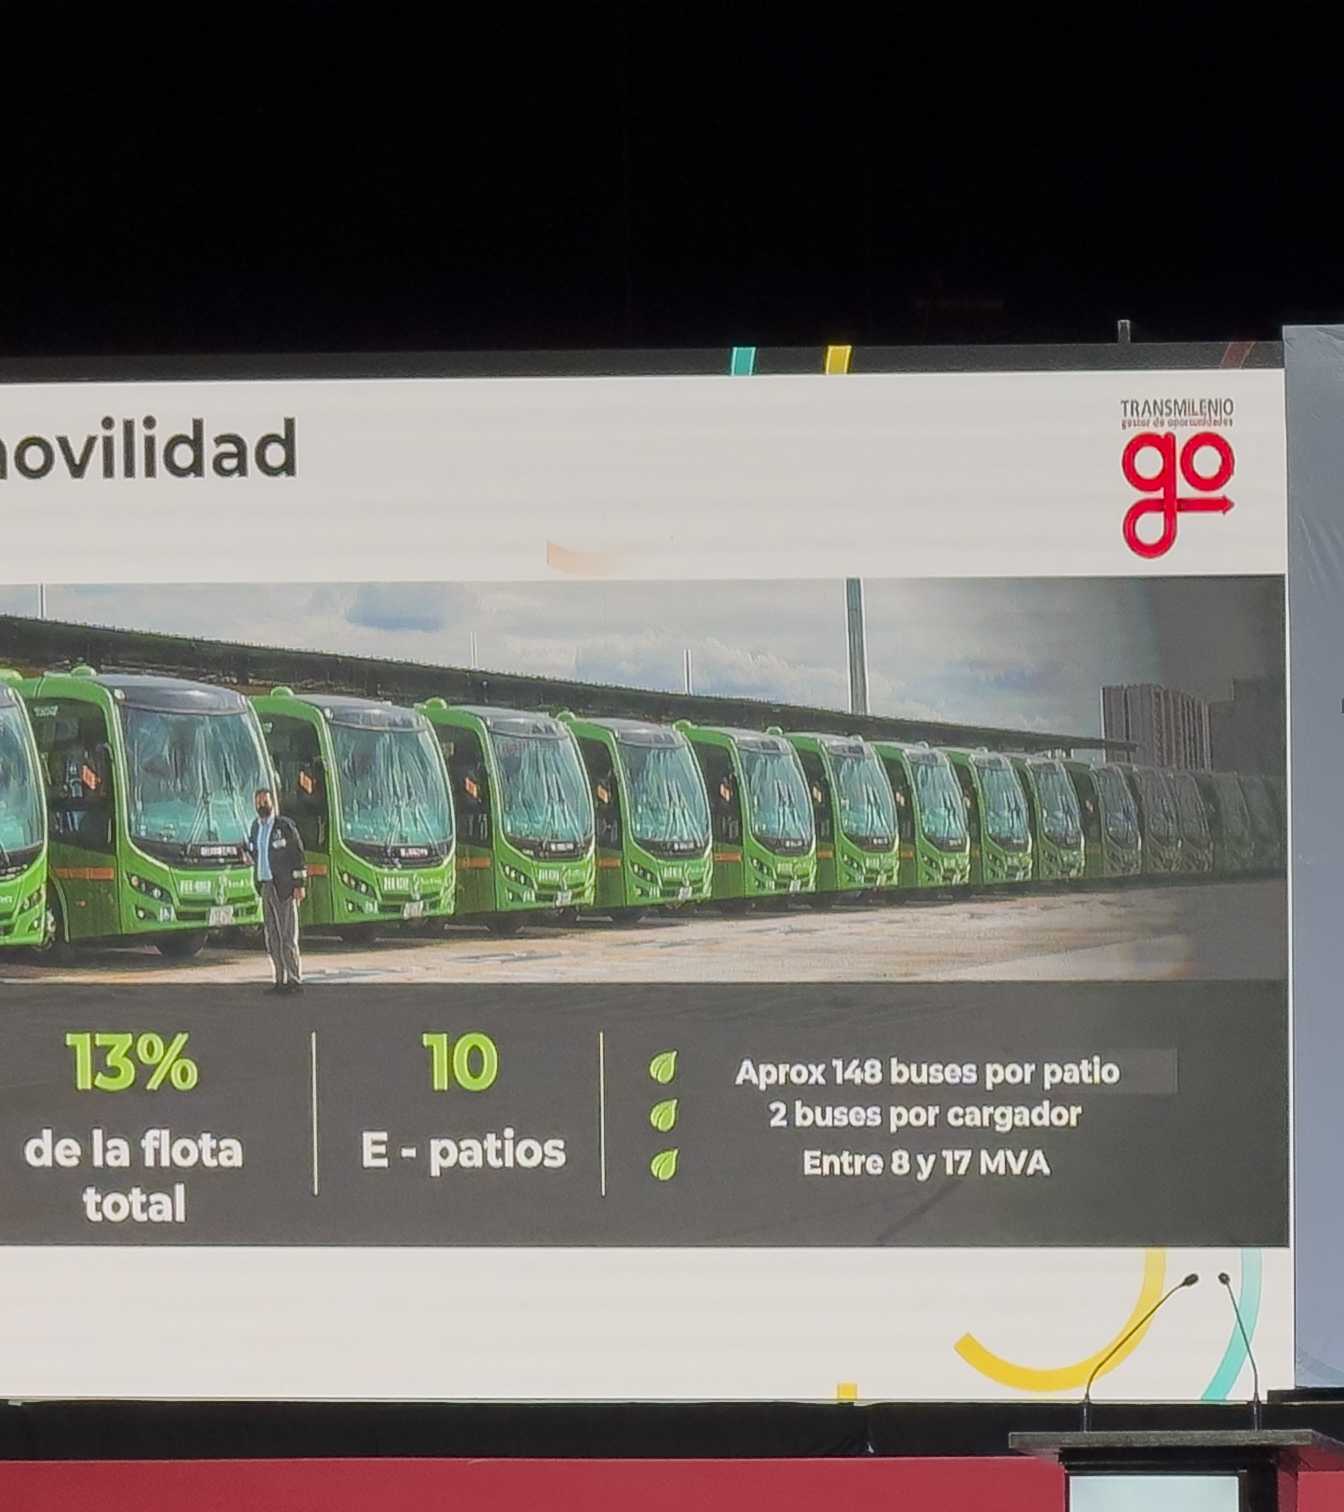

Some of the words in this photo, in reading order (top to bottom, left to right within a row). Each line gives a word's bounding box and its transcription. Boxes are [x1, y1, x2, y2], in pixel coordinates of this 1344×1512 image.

[1120, 399, 1234, 417] TRANSMILENIO
[1122, 432, 1235, 559] go
[65, 1031, 198, 1091] 13%
[423, 1031, 499, 1091] 10
[736, 1058, 826, 1091] Aprox
[831, 1058, 882, 1085] 148
[890, 1057, 977, 1086] buses
[986, 1063, 1035, 1091] por
[1044, 1055, 1120, 1091] patio
[769, 1102, 787, 1127] 2
[795, 1100, 881, 1128] buses
[889, 1105, 938, 1132] por
[947, 1100, 1082, 1132] cargador
[24, 1129, 81, 1168] de
[93, 1129, 130, 1168] la
[142, 1128, 243, 1168] flota
[362, 1132, 389, 1168] E
[431, 1128, 566, 1177] patios
[804, 1150, 882, 1177] Entre
[891, 1150, 910, 1177] 8
[916, 1155, 935, 1182] y
[941, 1150, 970, 1177] 17
[979, 1150, 1051, 1177] MVA
[83, 1183, 186, 1223] total
